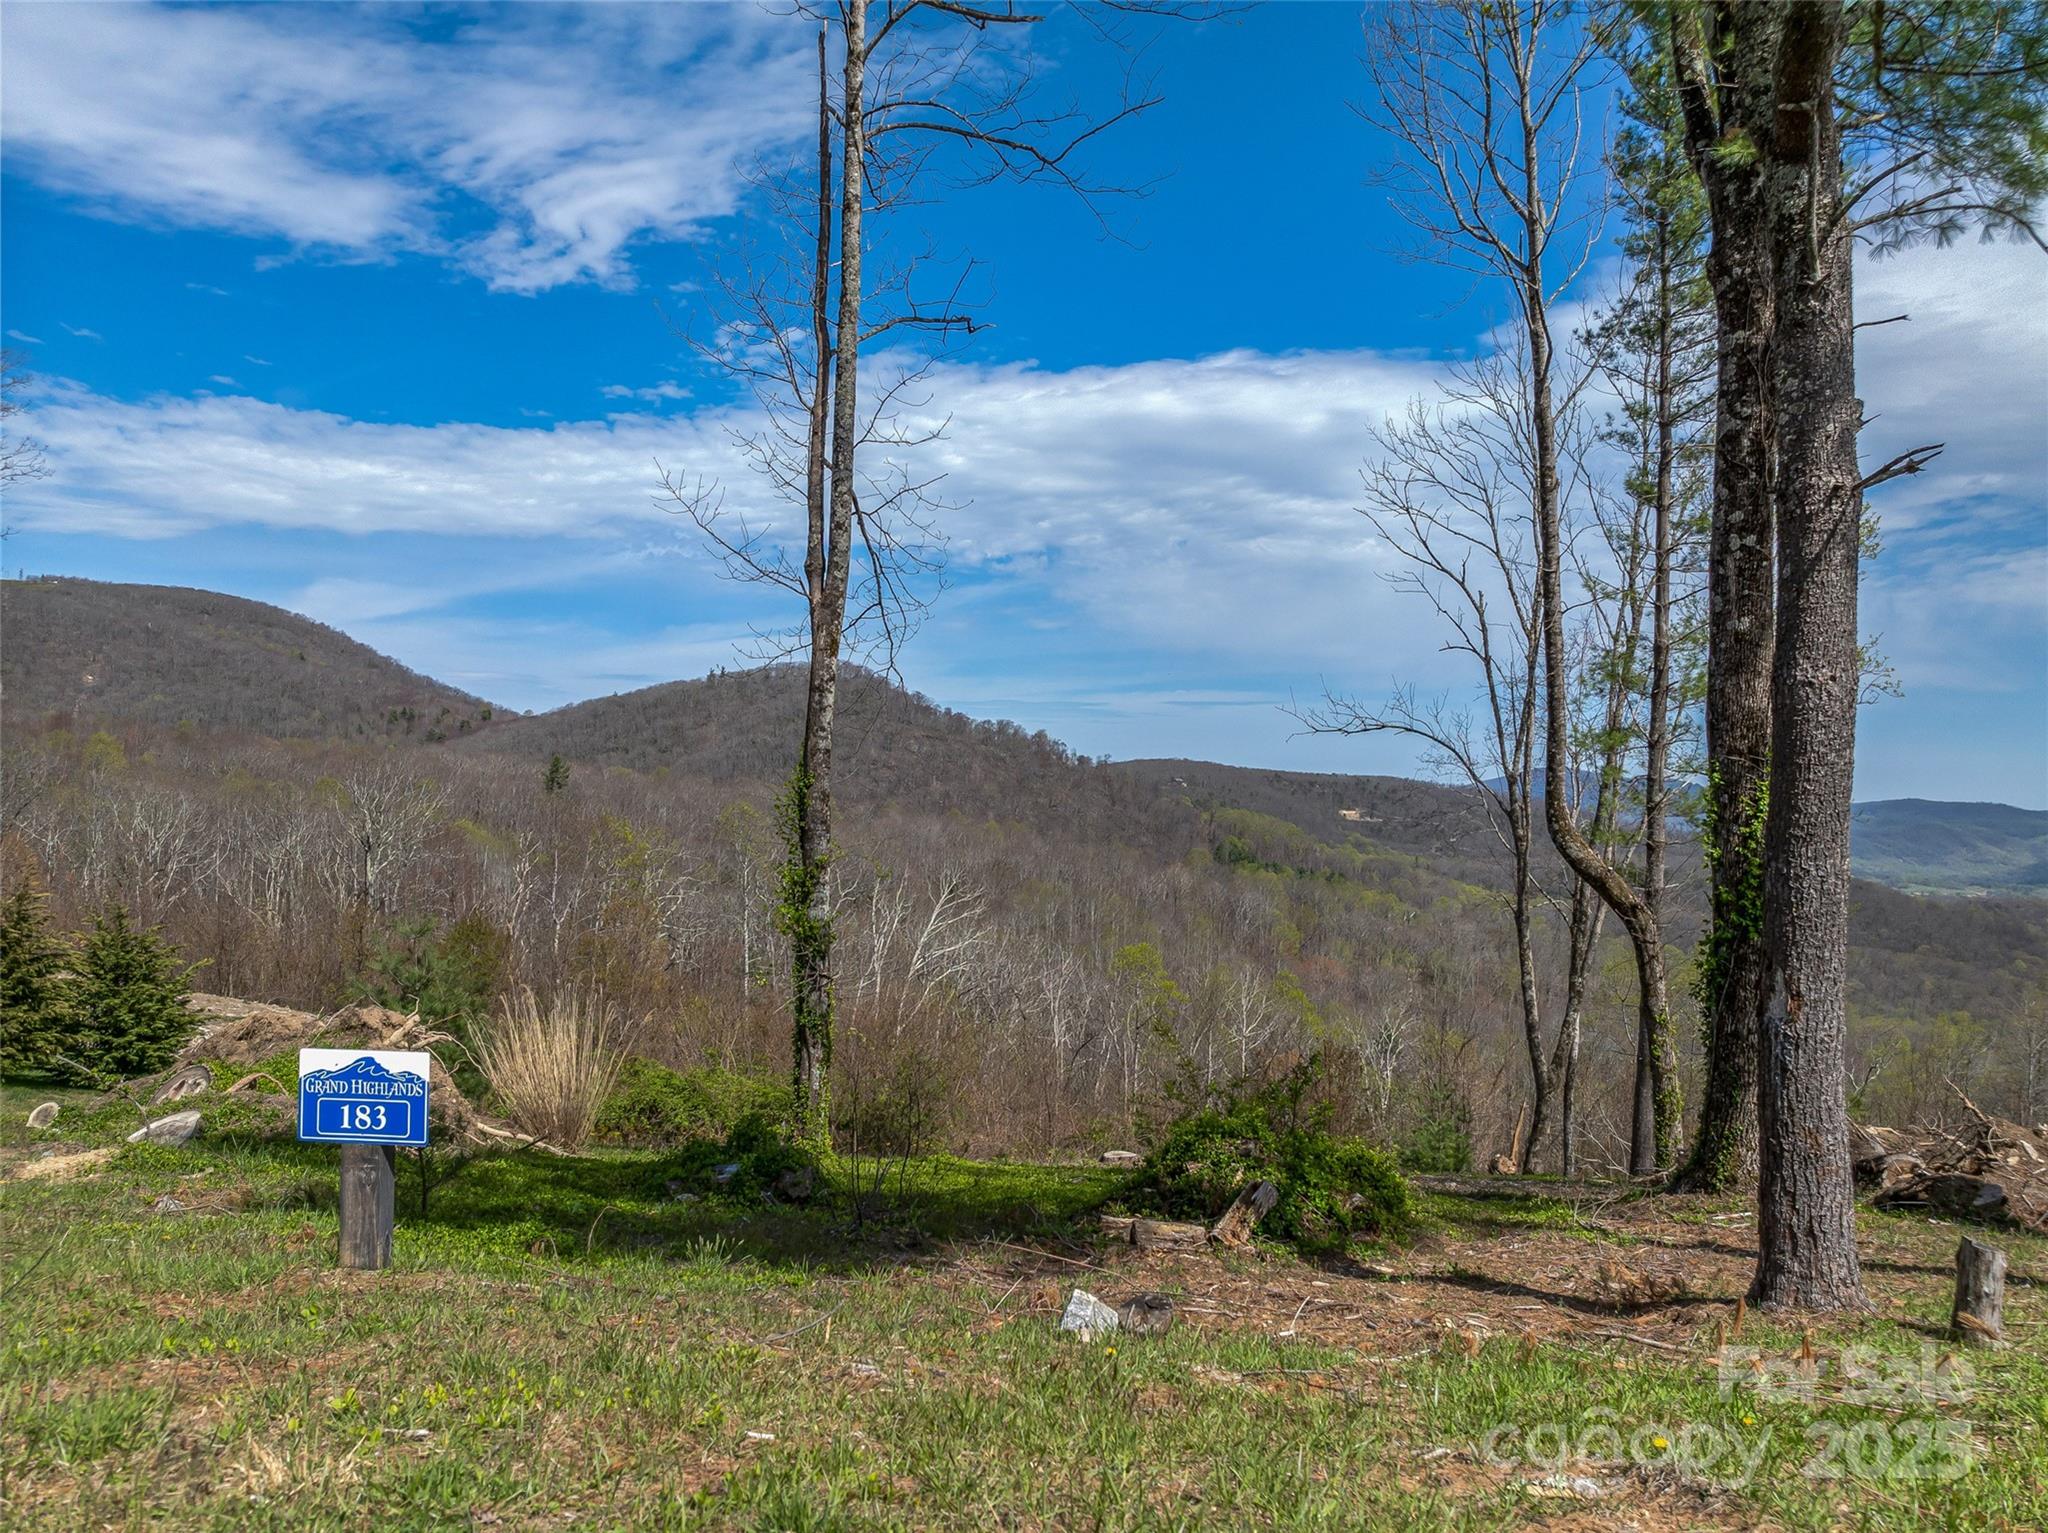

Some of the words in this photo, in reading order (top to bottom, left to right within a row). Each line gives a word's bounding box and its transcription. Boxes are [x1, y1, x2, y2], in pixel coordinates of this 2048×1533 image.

[305, 1077, 349, 1096] GRAND
[351, 1079, 424, 1099] HIGHLANDS
[340, 1104, 387, 1130] 183
